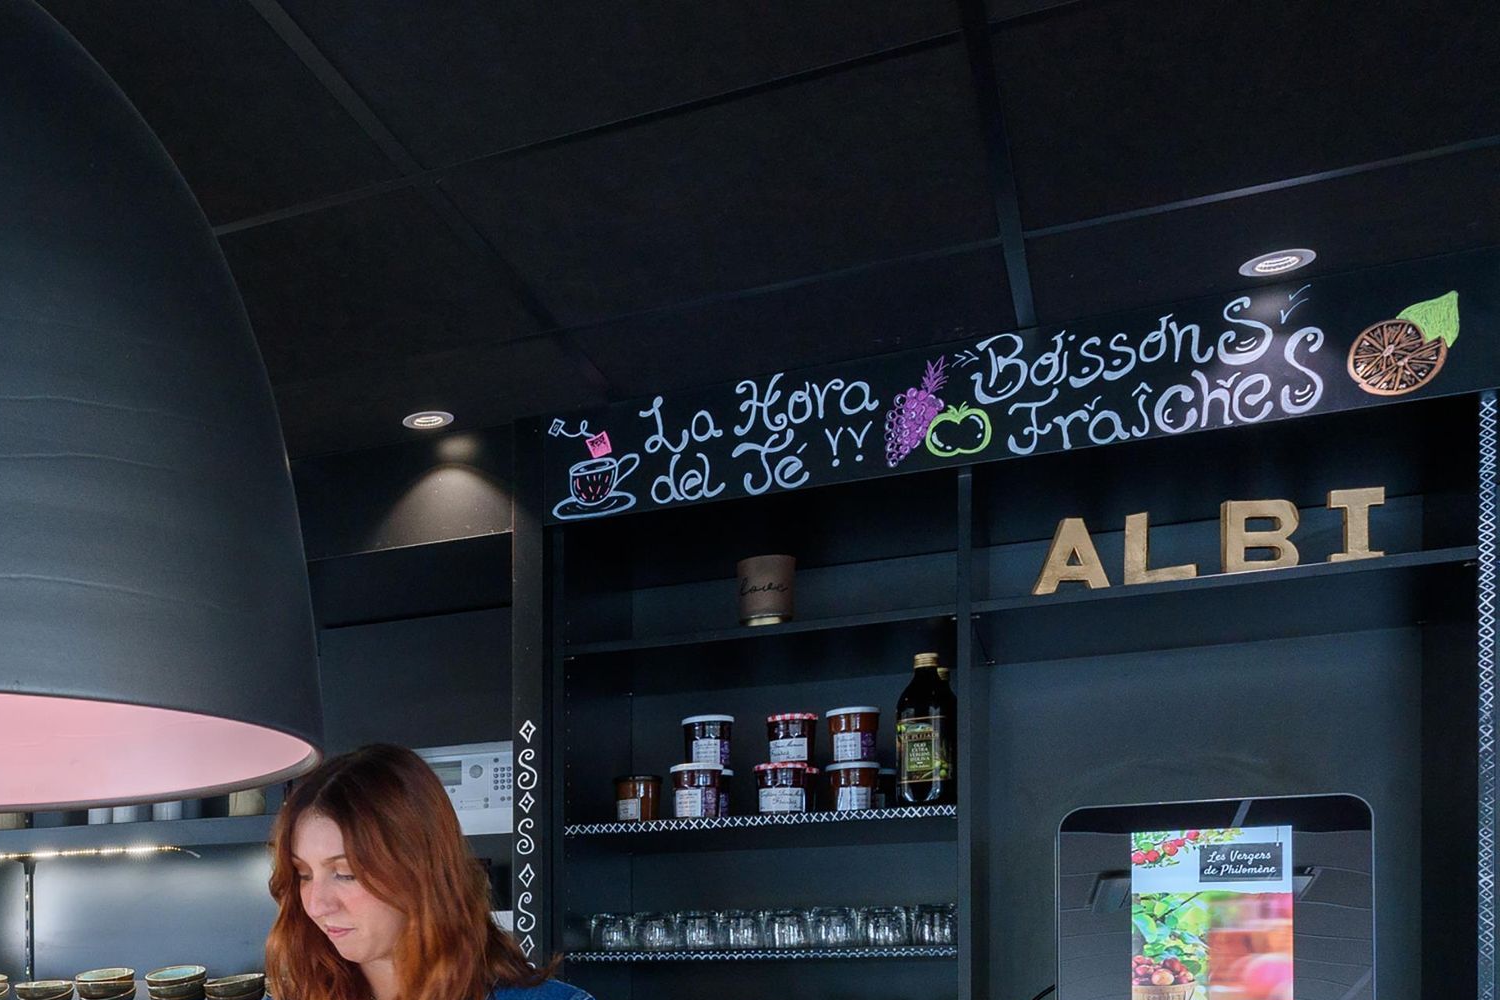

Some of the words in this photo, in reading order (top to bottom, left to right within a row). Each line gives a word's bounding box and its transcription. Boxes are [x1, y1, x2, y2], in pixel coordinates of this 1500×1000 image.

[639, 396, 723, 453] La
[734, 373, 879, 435] Hora
[651, 453, 726, 504] del
[732, 429, 809, 495] Té
[739, 576, 789, 598] love
[1206, 850, 1226, 863] Les
[1229, 850, 1271, 865] Vergers
[1203, 865, 1219, 875] de
[1219, 863, 1277, 876] Philomène
